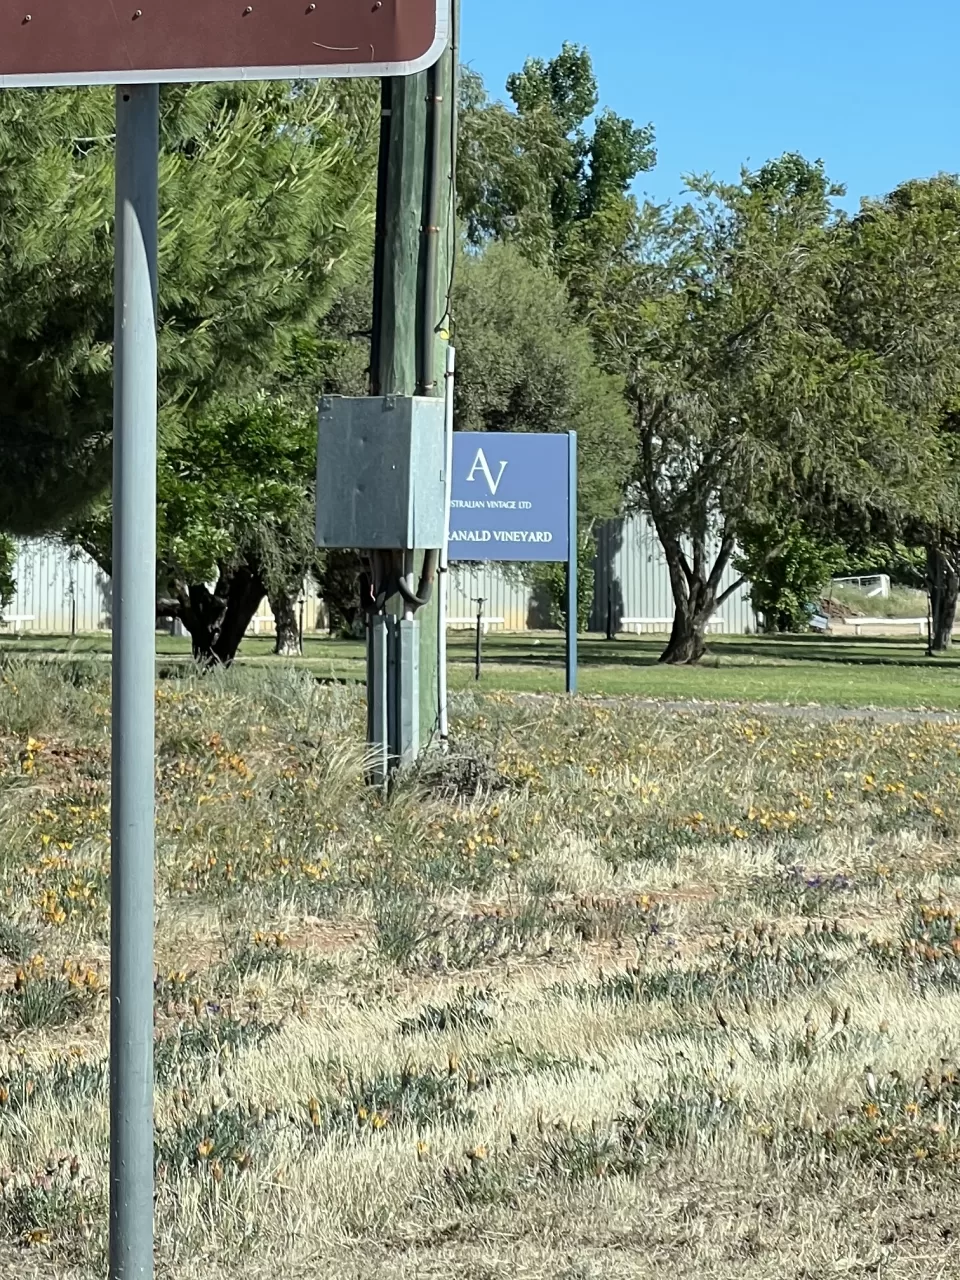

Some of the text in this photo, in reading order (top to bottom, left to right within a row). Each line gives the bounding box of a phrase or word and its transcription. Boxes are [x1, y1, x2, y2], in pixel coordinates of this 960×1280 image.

[465, 447, 509, 496] AV
[450, 499, 532, 510] STRALIAN VINTAGE LTD
[493, 531, 553, 543] VINEYARD
